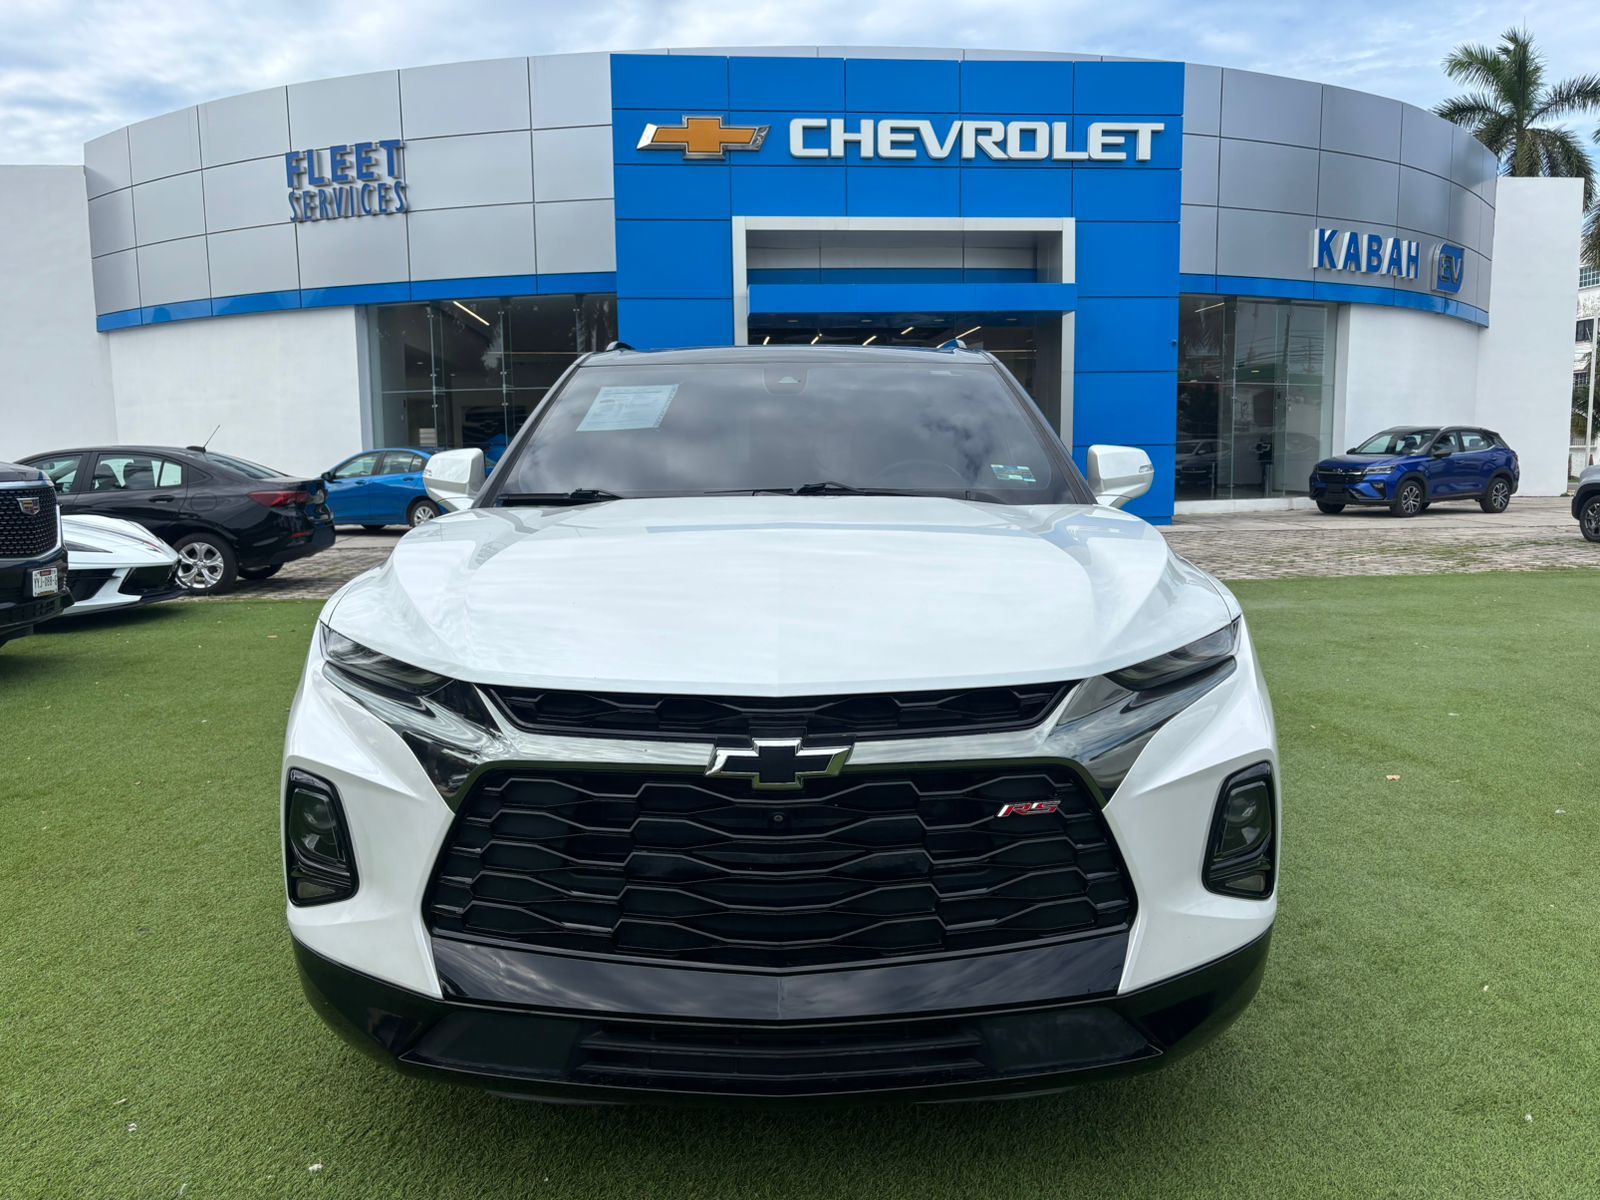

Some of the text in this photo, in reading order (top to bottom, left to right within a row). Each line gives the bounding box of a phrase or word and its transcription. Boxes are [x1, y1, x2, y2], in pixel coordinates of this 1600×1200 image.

[789, 118, 1164, 162] CHEVROLET
[285, 139, 404, 189] FLEET
[288, 180, 406, 222] SERVICES
[1313, 228, 1420, 279] KABAH
[1439, 254, 1463, 283] EV
[997, 800, 1060, 817] RS
